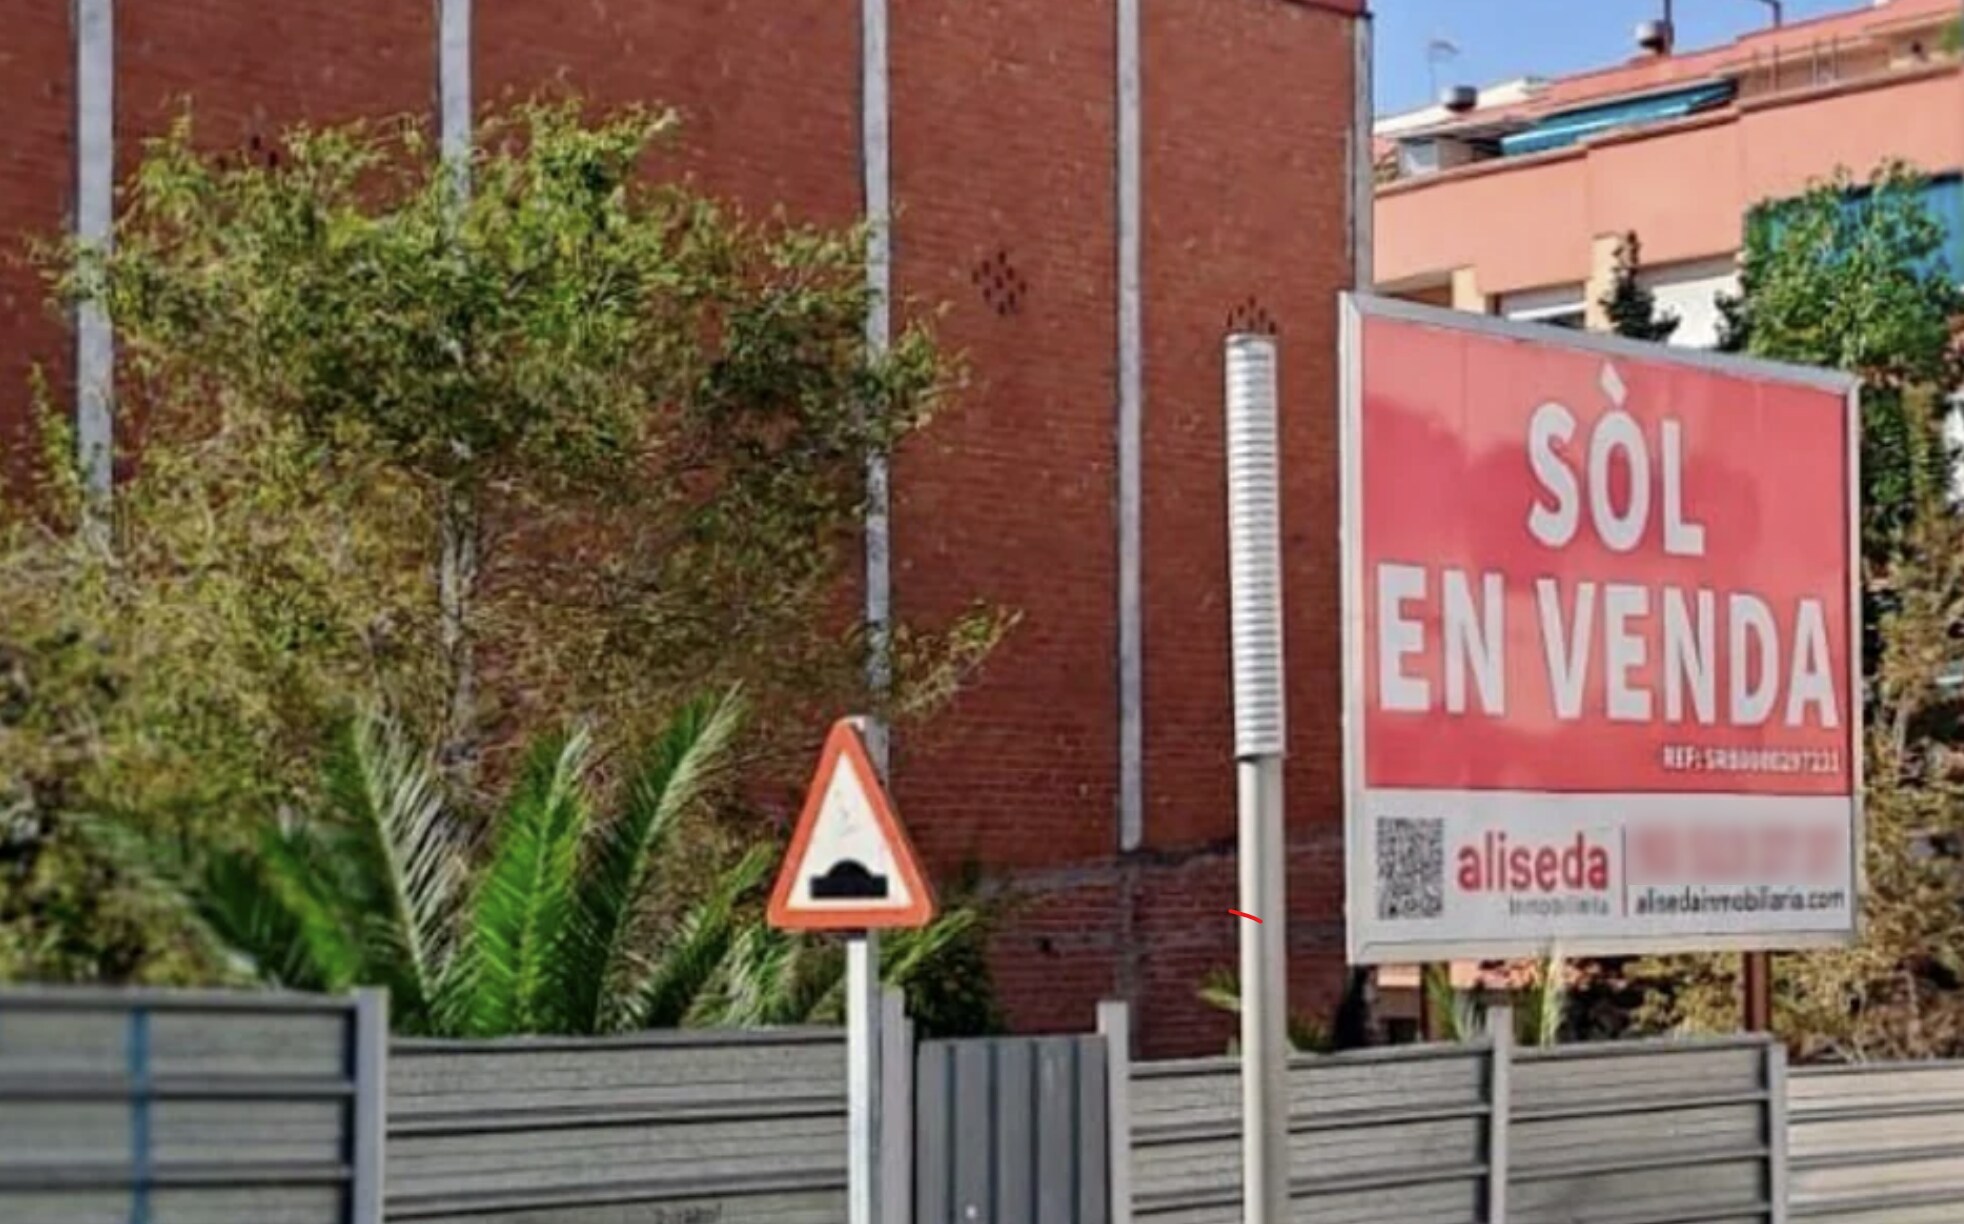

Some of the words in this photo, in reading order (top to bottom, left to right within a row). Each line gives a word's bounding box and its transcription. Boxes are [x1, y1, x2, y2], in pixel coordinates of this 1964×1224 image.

[1528, 363, 1705, 555] SÒL
[1376, 563, 1506, 715] EN
[1537, 579, 1840, 728] VENDA
[1457, 830, 1609, 891] aliseda
